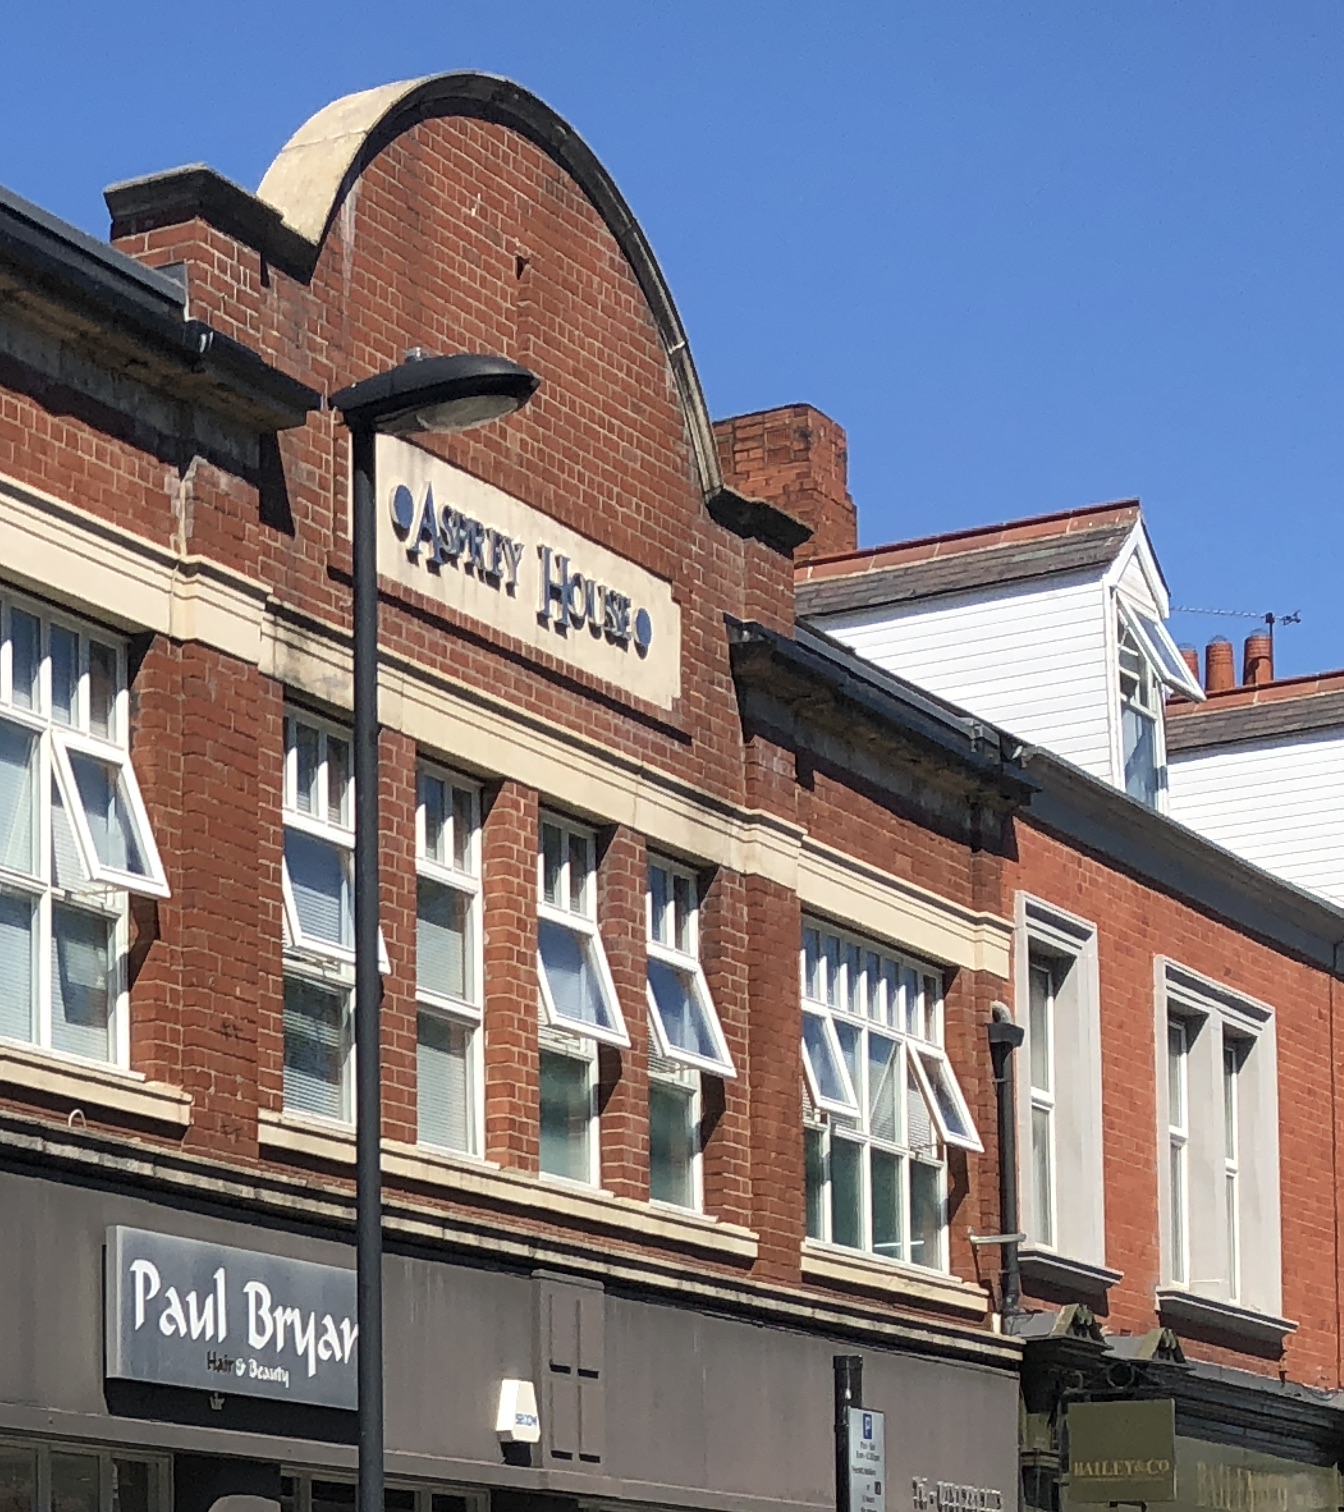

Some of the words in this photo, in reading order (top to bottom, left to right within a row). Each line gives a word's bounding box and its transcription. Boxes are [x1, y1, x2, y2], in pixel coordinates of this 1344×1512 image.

[406, 481, 525, 588] ASPREY
[536, 538, 633, 640] HOUSE
[129, 1258, 227, 1344] Paul
[207, 1351, 234, 1374] Hair
[248, 1358, 290, 1389] Beauty
